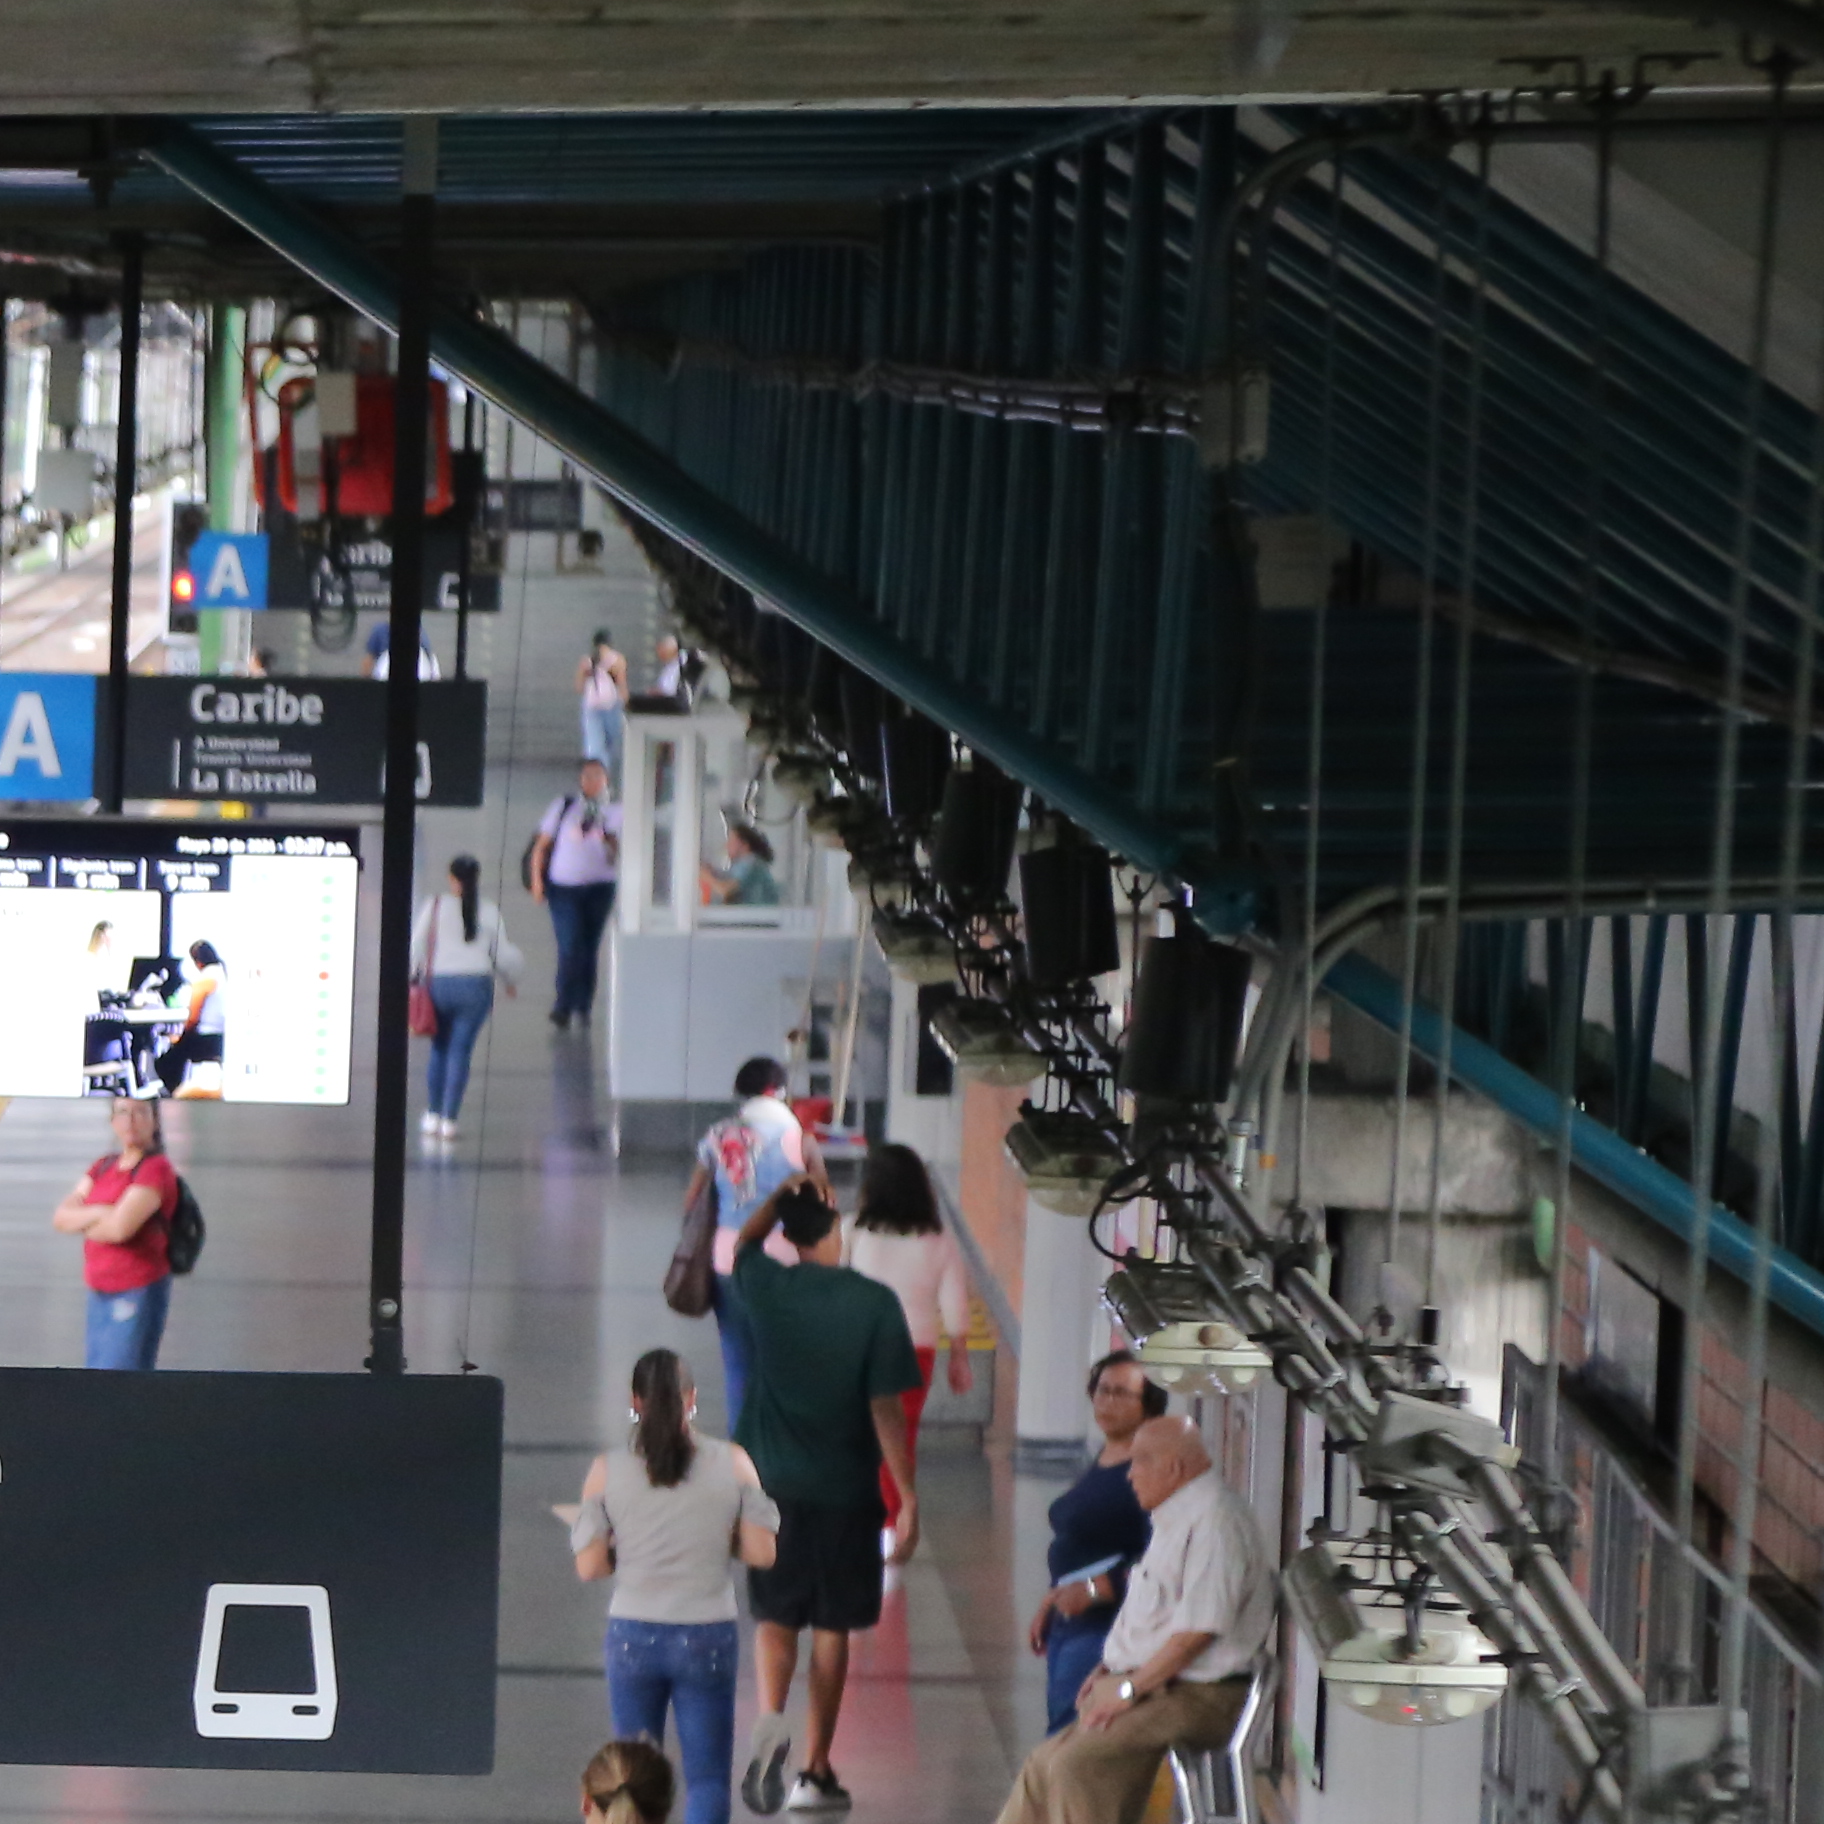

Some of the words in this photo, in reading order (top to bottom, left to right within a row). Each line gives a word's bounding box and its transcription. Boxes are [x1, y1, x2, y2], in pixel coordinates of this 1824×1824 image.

[206, 543, 250, 599] A
[190, 683, 325, 726] Caribe
[207, 736, 281, 752] Universidad
[190, 767, 220, 793] La
[225, 768, 318, 795] Estrella
